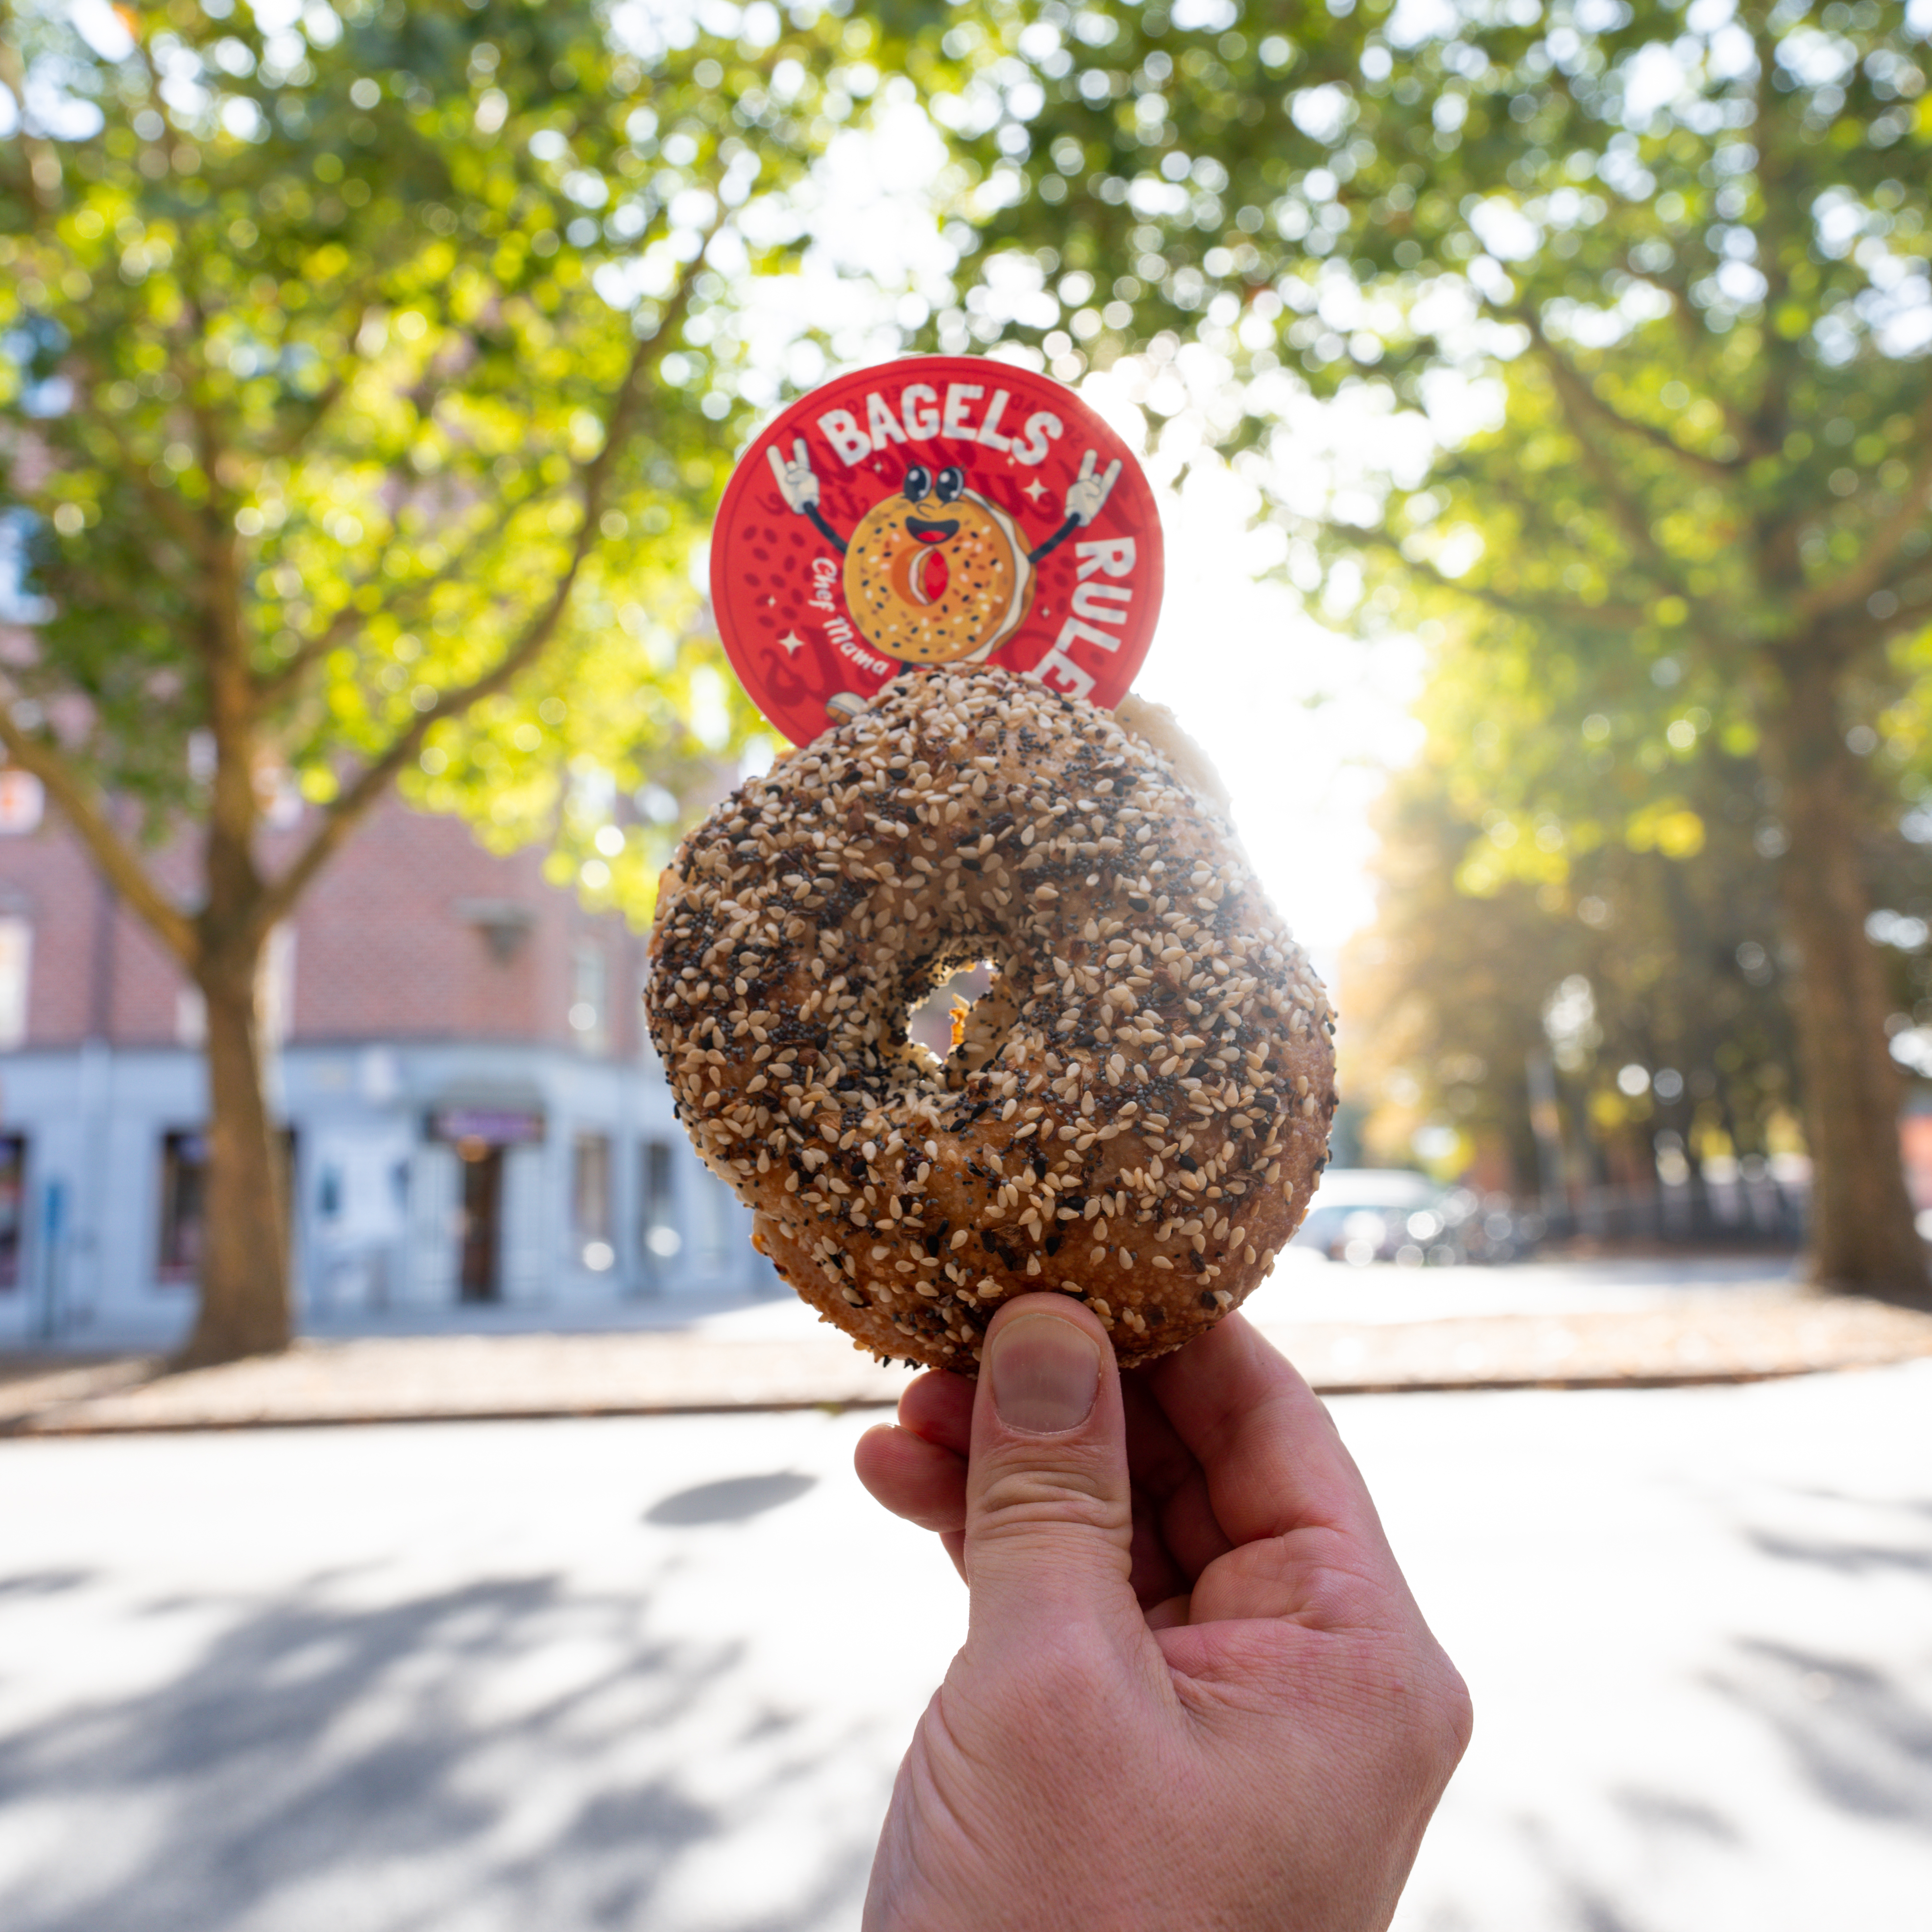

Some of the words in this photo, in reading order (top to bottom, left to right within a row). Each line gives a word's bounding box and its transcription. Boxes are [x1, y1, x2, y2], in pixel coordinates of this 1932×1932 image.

[817, 383, 1063, 467] BAGELS
[808, 557, 838, 612] Chef
[1031, 536, 1136, 700] RULE
[822, 615, 890, 676] Mama
